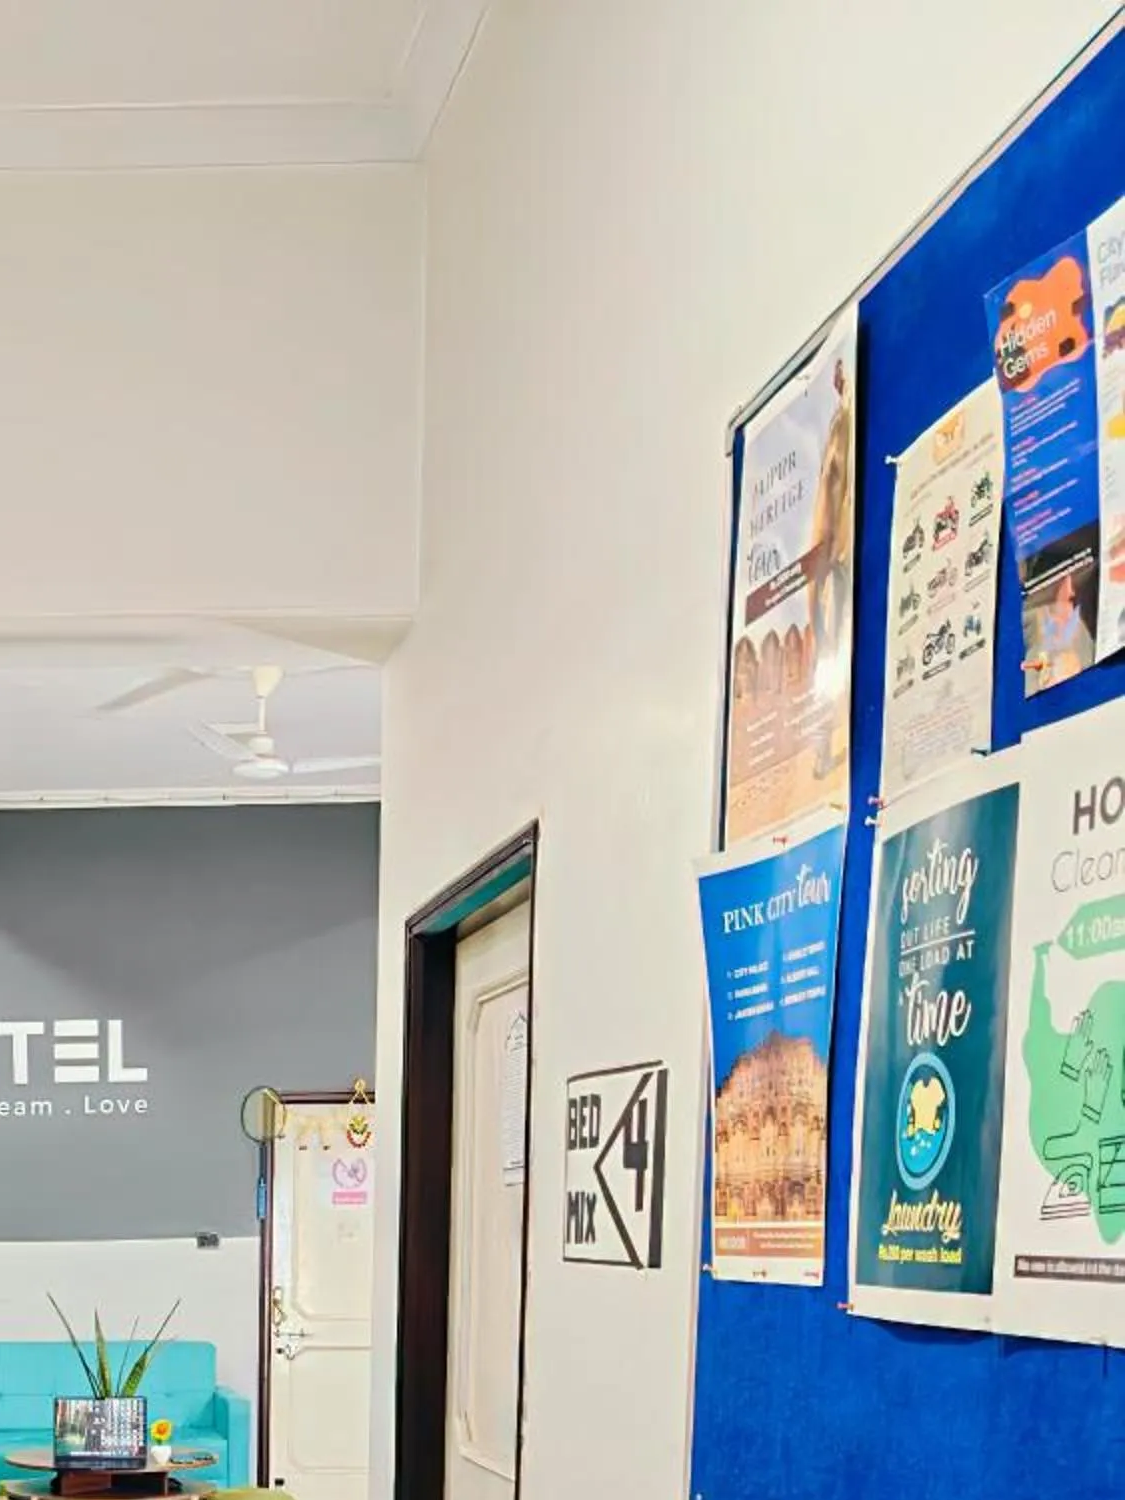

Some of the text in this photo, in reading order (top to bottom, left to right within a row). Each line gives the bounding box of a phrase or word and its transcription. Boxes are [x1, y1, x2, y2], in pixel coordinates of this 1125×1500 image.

[1001, 309, 1057, 357] Hidden
[1003, 343, 1050, 380] Gems
[900, 838, 979, 925] sorting
[723, 902, 764, 934] PINK
[766, 890, 796, 921] CITY
[901, 916, 951, 949] OUT LIFE
[898, 940, 975, 977] ONE LOAD AT
[904, 972, 972, 1047] time
[84, 1095, 148, 1114] Love
[568, 1094, 602, 1150] BED
[623, 1097, 649, 1212] 4
[566, 1191, 597, 1244] MIX
